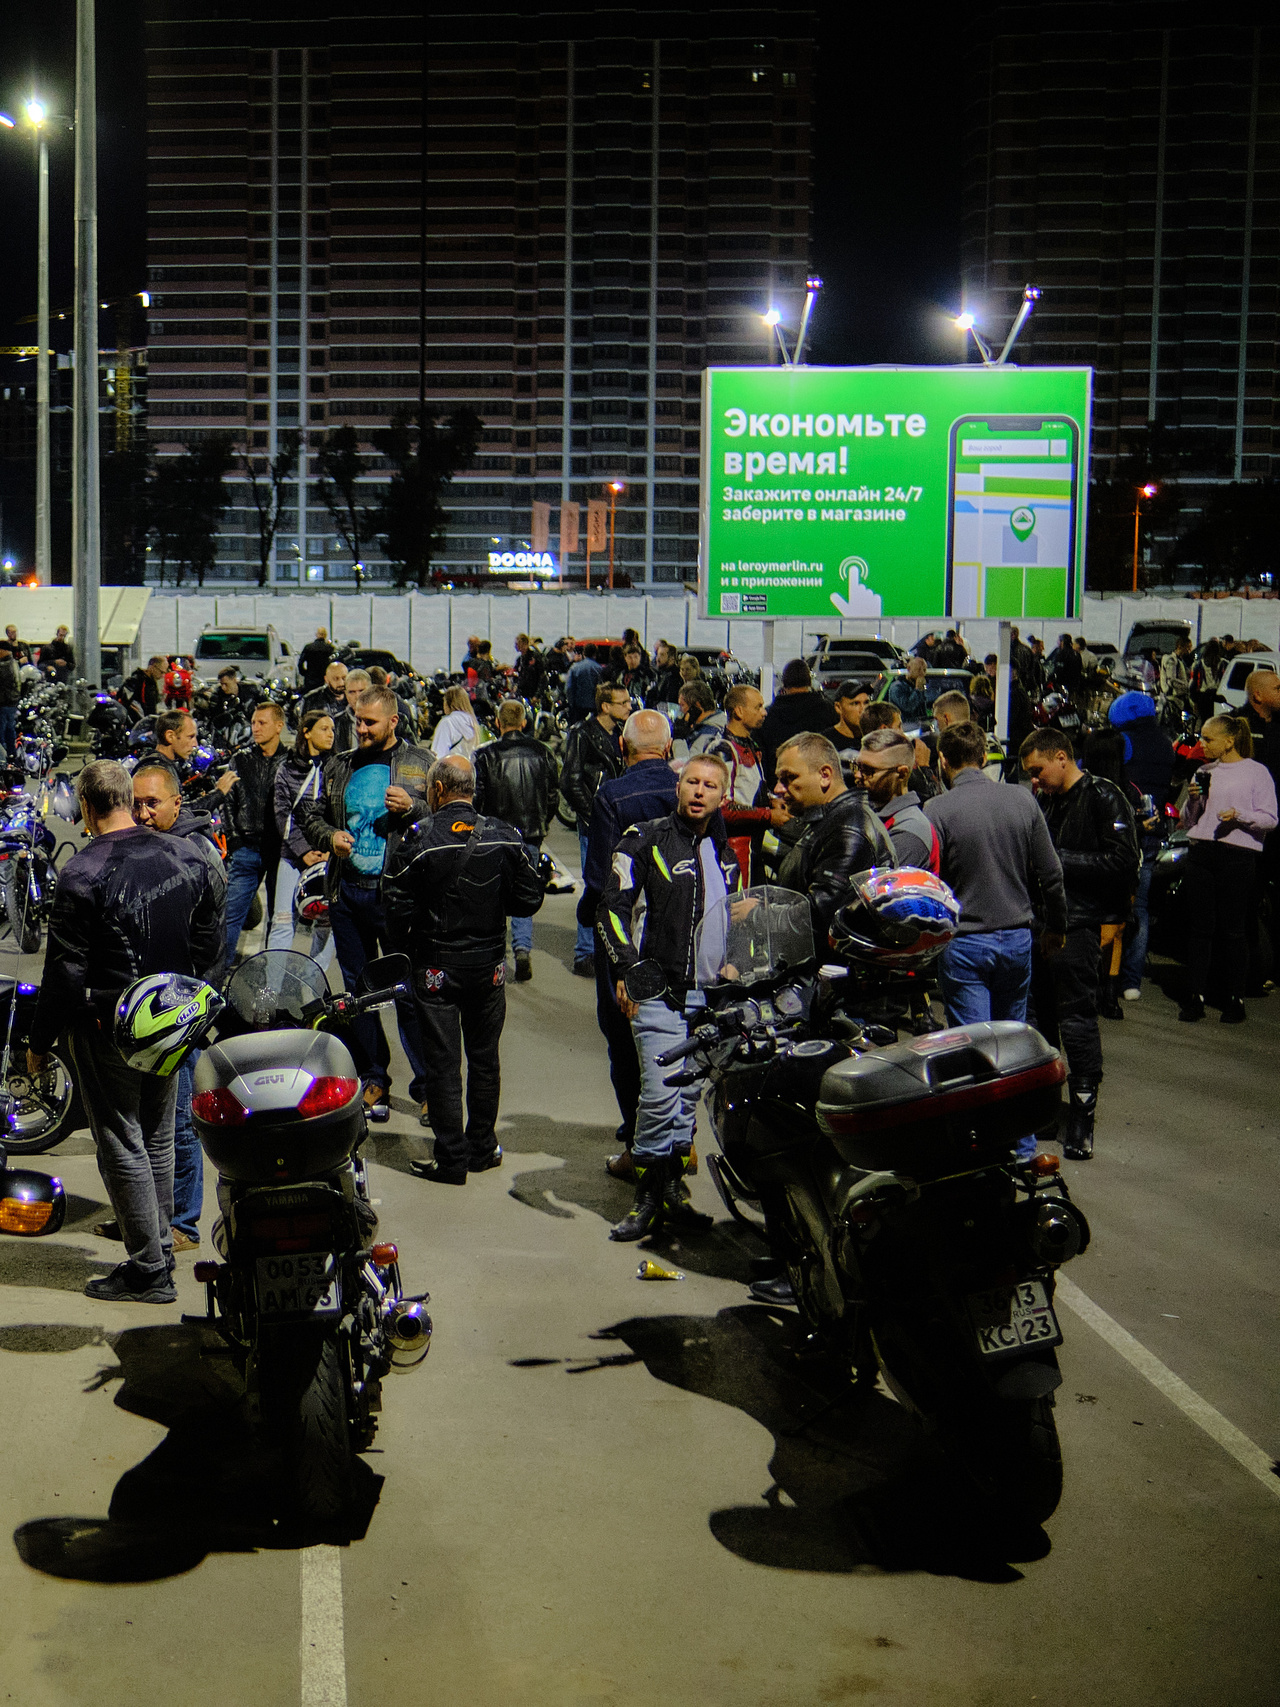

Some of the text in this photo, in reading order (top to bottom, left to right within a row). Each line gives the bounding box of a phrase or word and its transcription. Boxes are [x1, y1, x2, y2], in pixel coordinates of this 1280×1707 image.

[724, 407, 927, 437] Экономьте
[724, 446, 848, 482] время!
[723, 485, 923, 502] Закажите онлайн 24/7
[722, 504, 906, 524] заберите в магазине
[488, 552, 554, 567] DOGMA
[721, 560, 823, 574] на leroymerlin.ru
[721, 577, 822, 589] и в приложении
[179, 1003, 198, 1022] HJC
[253, 1074, 285, 1086] GIVI
[265, 1193, 309, 1207] YAMAHA
[268, 1256, 324, 1279] 0053
[306, 1287, 332, 1306] 63
[1013, 1308, 1032, 1318] RUS
[980, 1315, 1051, 1350] KC 23
